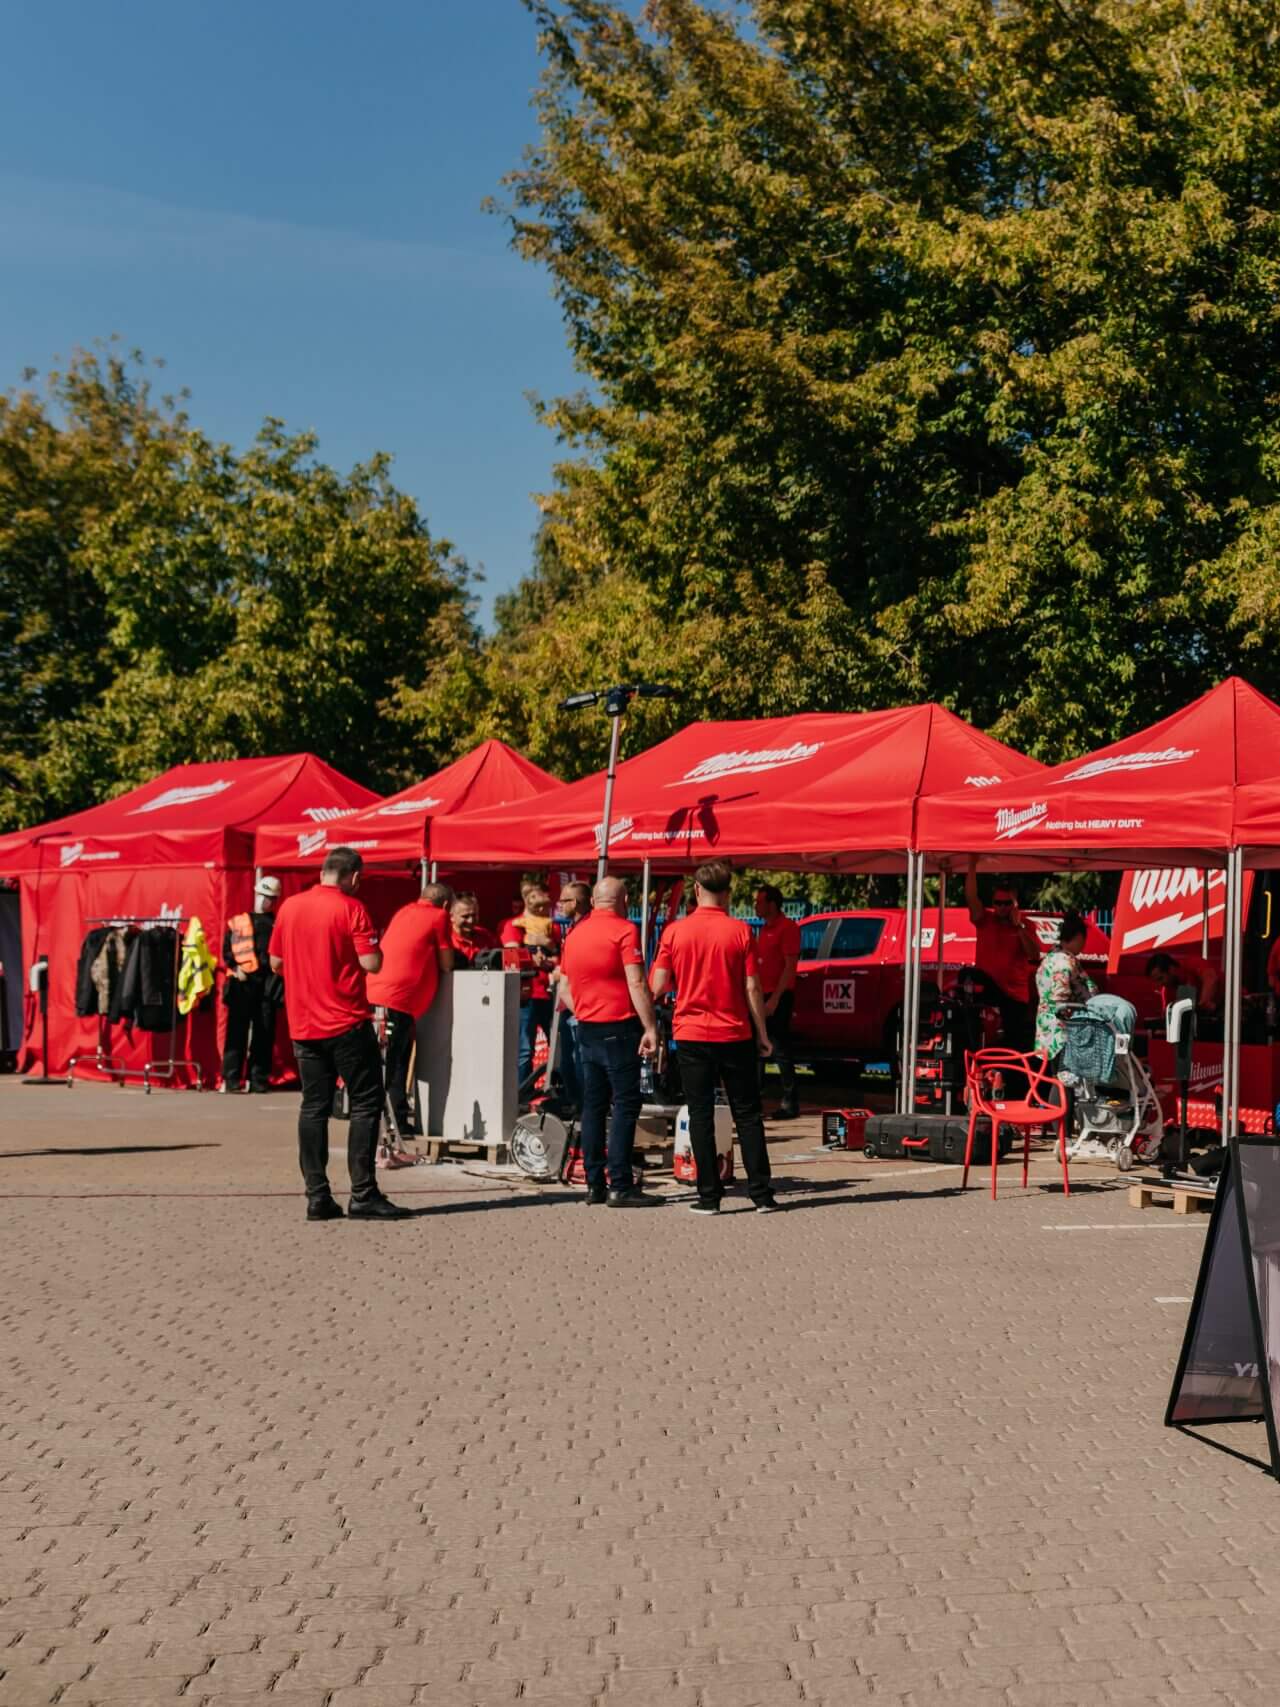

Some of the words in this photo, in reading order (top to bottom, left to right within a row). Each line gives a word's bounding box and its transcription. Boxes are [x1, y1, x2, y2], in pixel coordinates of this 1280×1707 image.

[683, 742, 819, 780] Milwaukee
[995, 801, 1048, 833] Milwaukee
[1046, 820, 1074, 831] Nothing
[1075, 820, 1087, 829] but
[1088, 819, 1117, 829] HEAVY
[825, 983, 852, 1000] MX
[825, 1001, 852, 1010] FUEL
